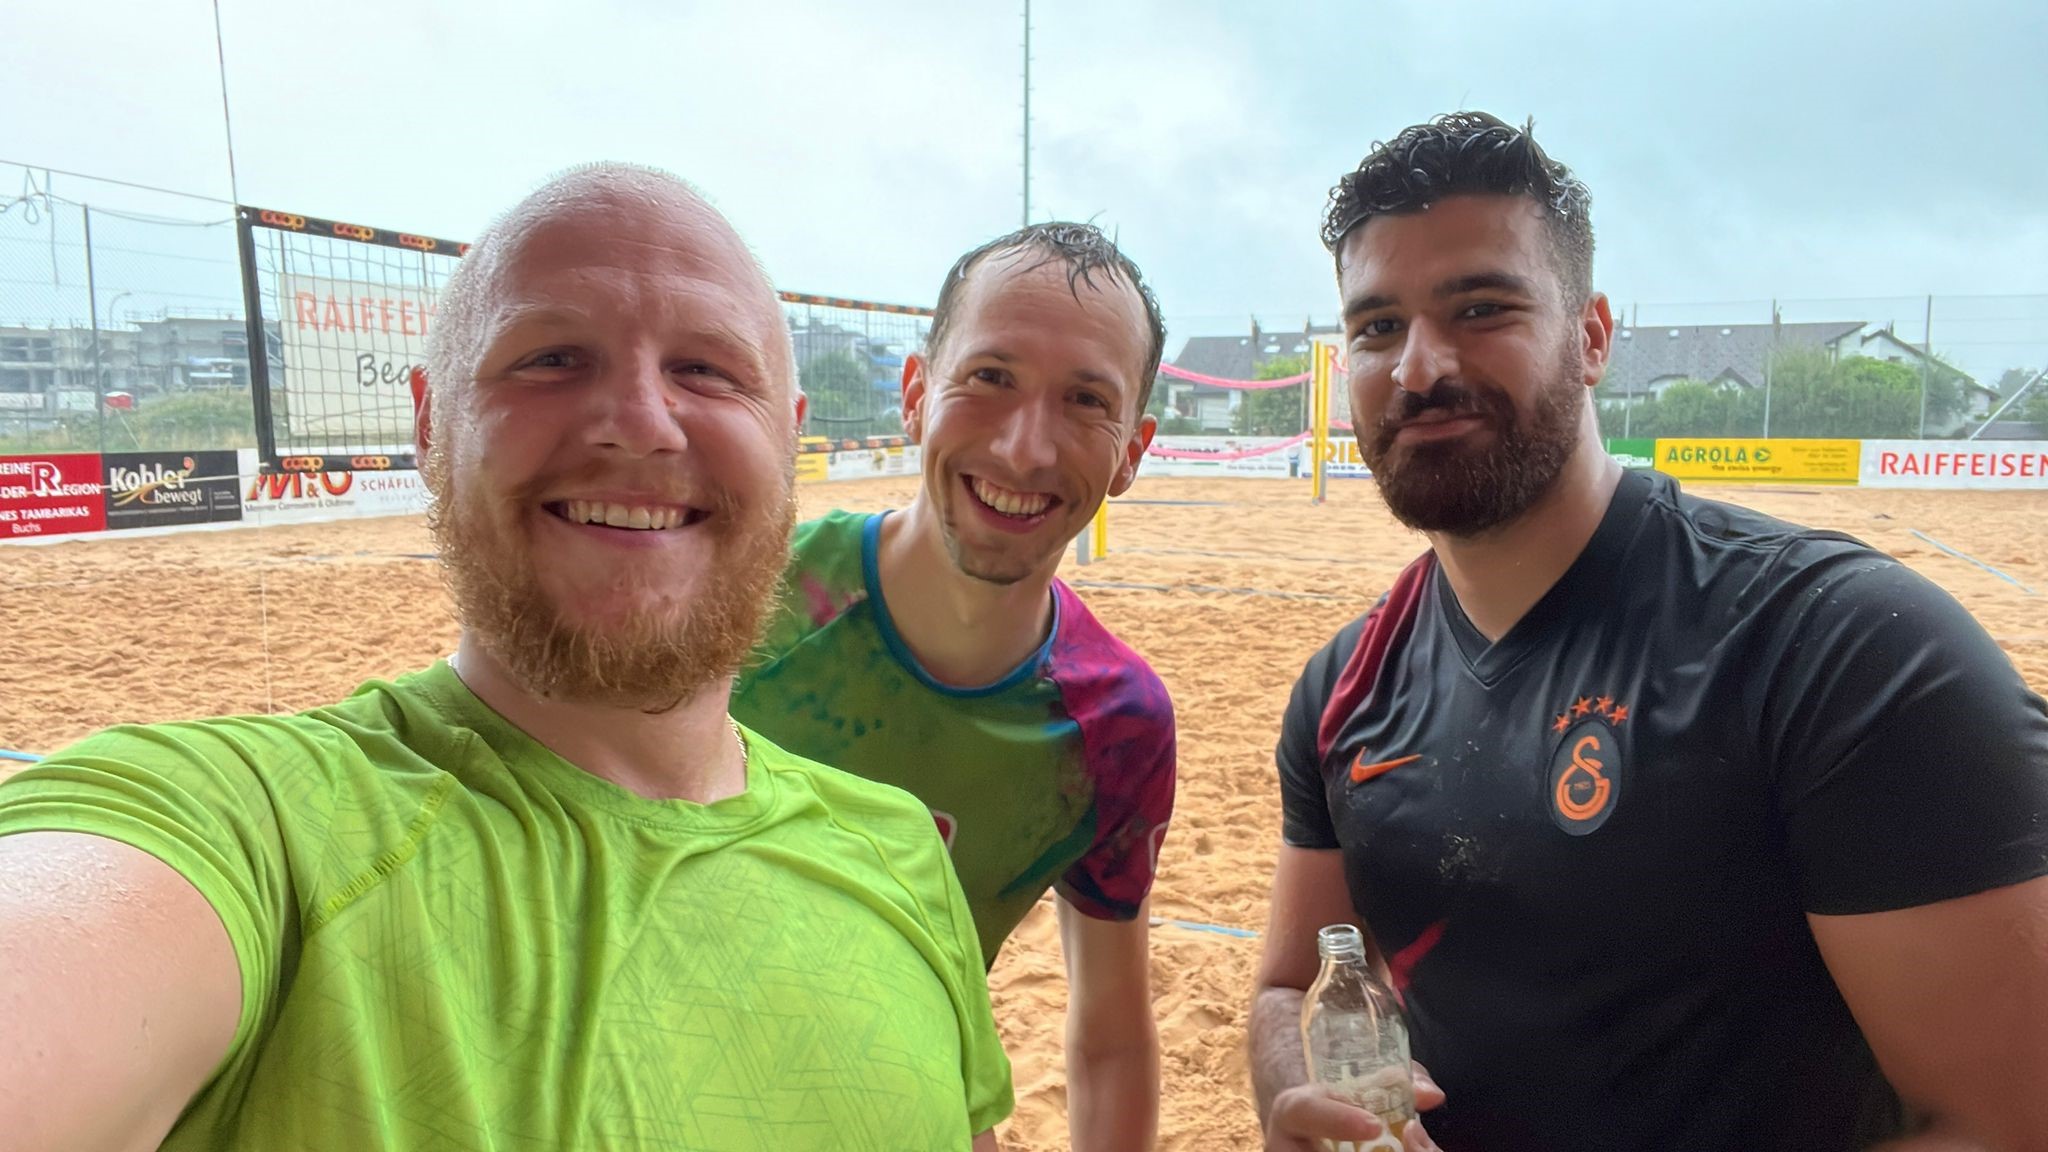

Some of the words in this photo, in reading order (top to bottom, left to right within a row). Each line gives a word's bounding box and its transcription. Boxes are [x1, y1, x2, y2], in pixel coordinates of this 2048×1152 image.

[261, 210, 305, 230] coop
[334, 223, 374, 241] coop
[352, 456, 391, 471] coop
[1668, 447, 1749, 463] AGROLA
[282, 456, 324, 473] coop
[154, 488, 203, 506] bewegt
